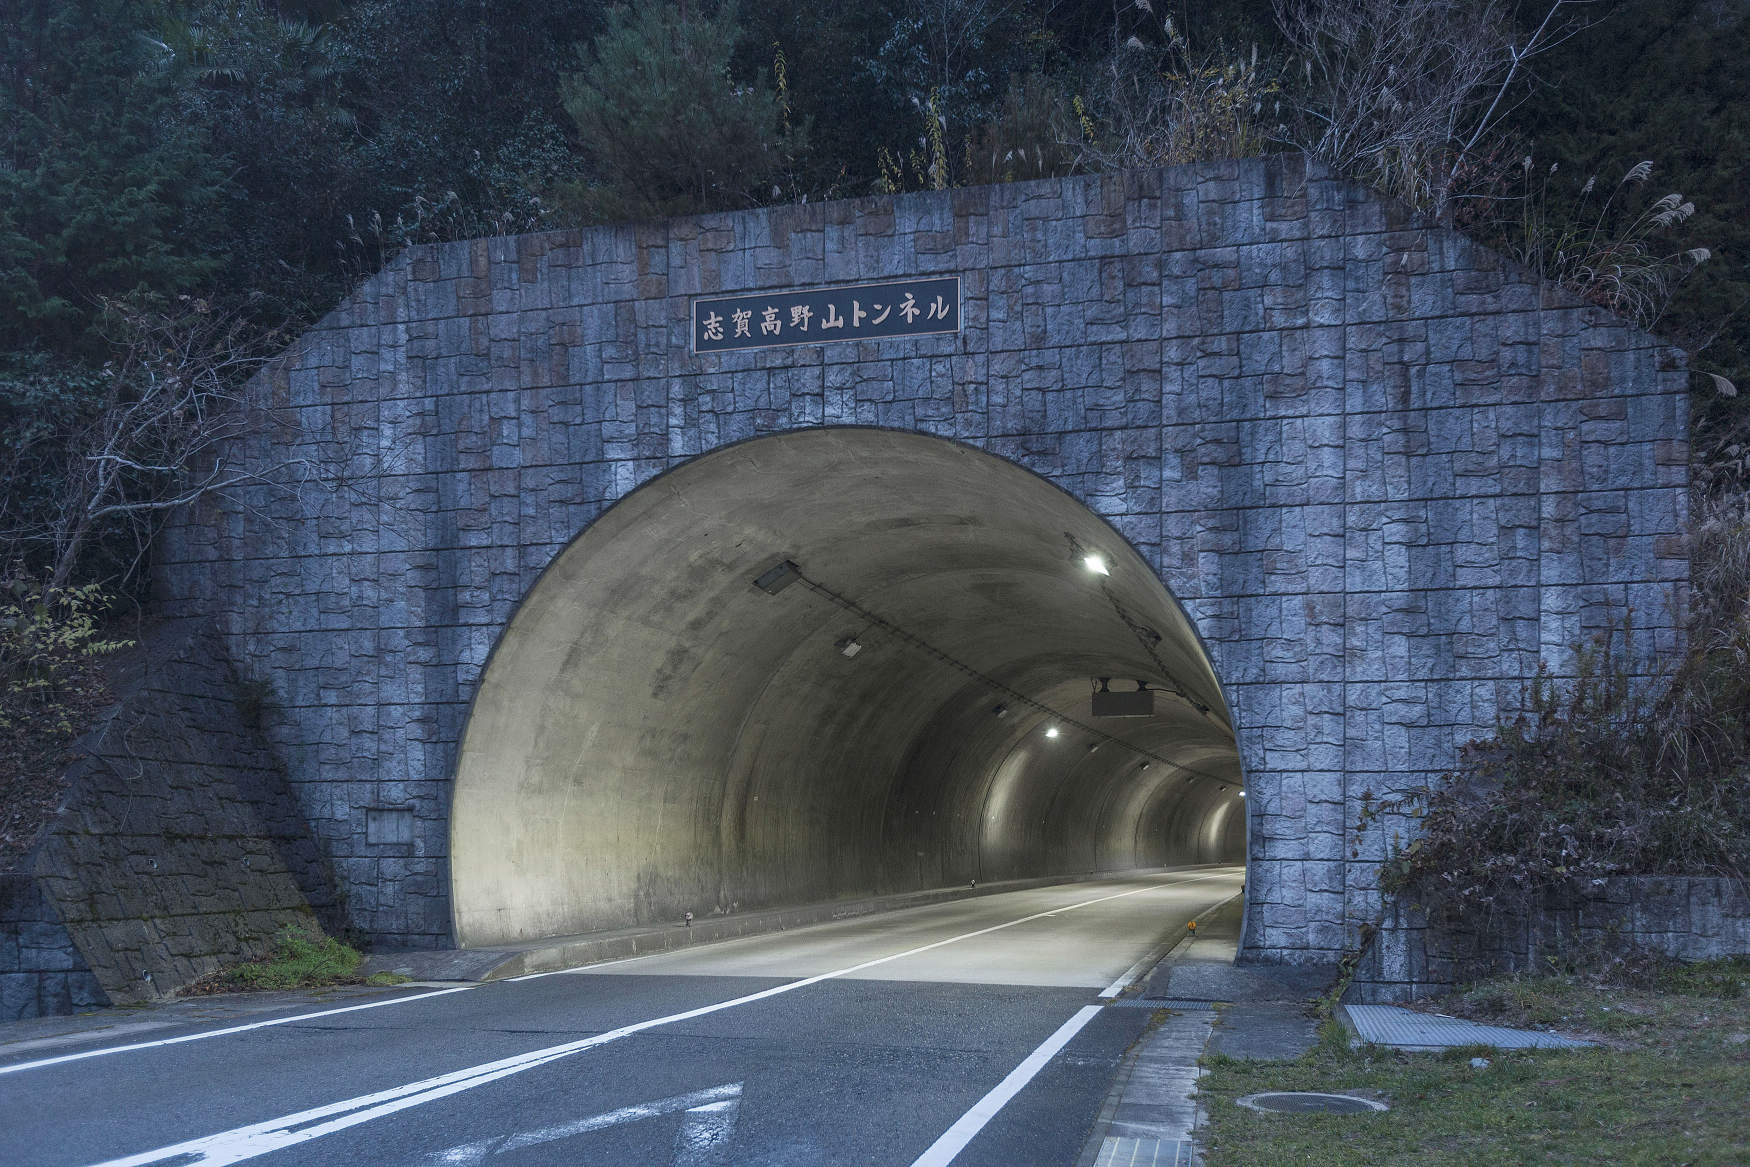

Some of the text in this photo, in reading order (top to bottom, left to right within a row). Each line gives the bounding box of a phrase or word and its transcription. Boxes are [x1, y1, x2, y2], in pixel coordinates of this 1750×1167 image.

[702, 292, 950, 341] 志賀高野山トンネル
